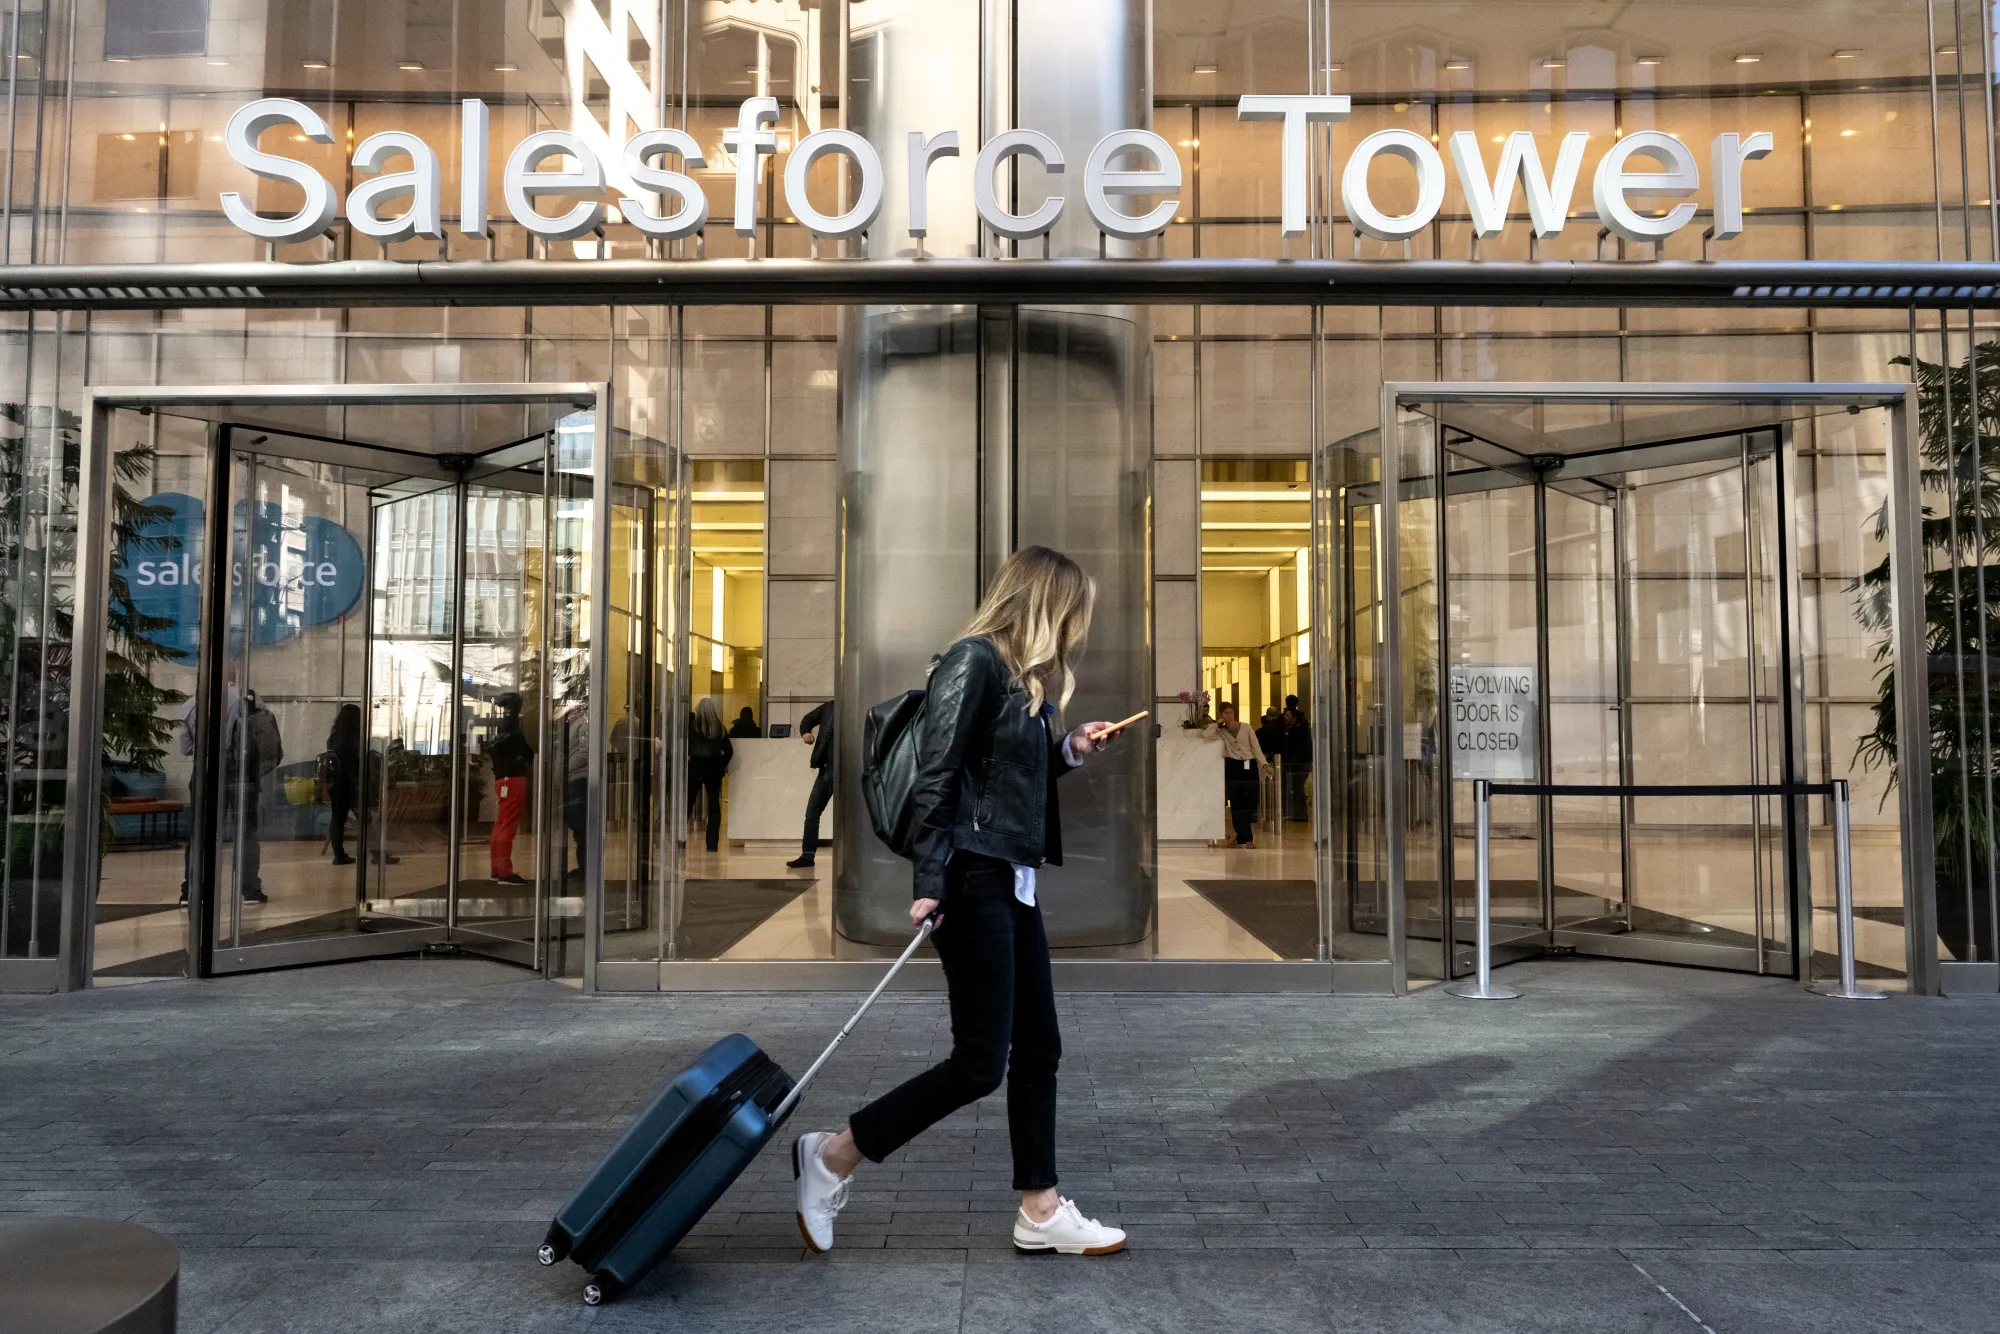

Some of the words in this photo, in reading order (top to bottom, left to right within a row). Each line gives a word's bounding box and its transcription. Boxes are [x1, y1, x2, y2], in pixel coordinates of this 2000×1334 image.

[220, 96, 1182, 241] Salesforce
[1237, 94, 1774, 242] Tower
[1456, 704, 1500, 722] DOOR
[1505, 704, 1519, 722] IS
[1457, 732, 1519, 750] CLOSED
